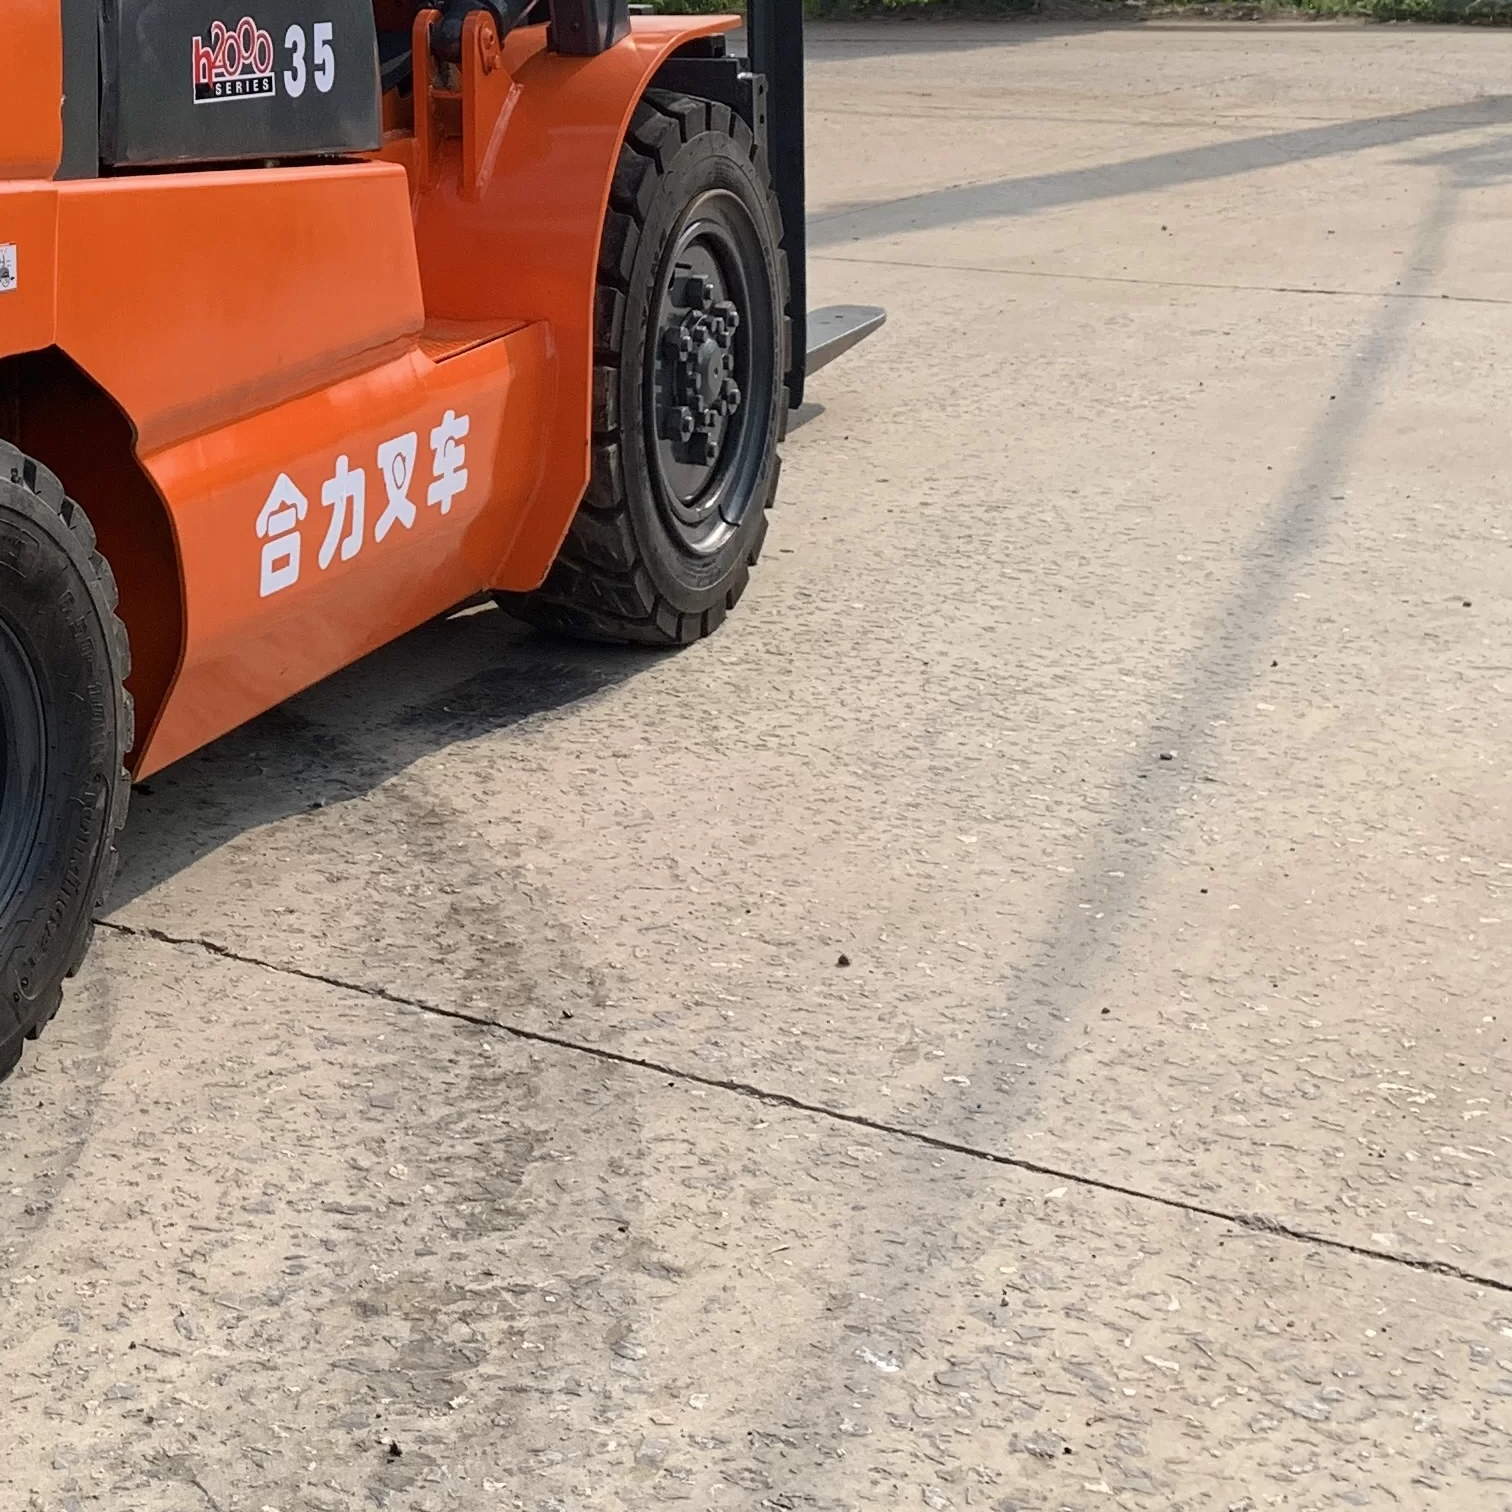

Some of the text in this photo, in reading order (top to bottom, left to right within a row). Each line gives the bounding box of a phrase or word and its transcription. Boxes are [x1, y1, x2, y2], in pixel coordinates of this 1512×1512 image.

[214, 78, 270, 96] SERIES
[283, 21, 335, 98] 35
[255, 409, 470, 598] 合力叉车
